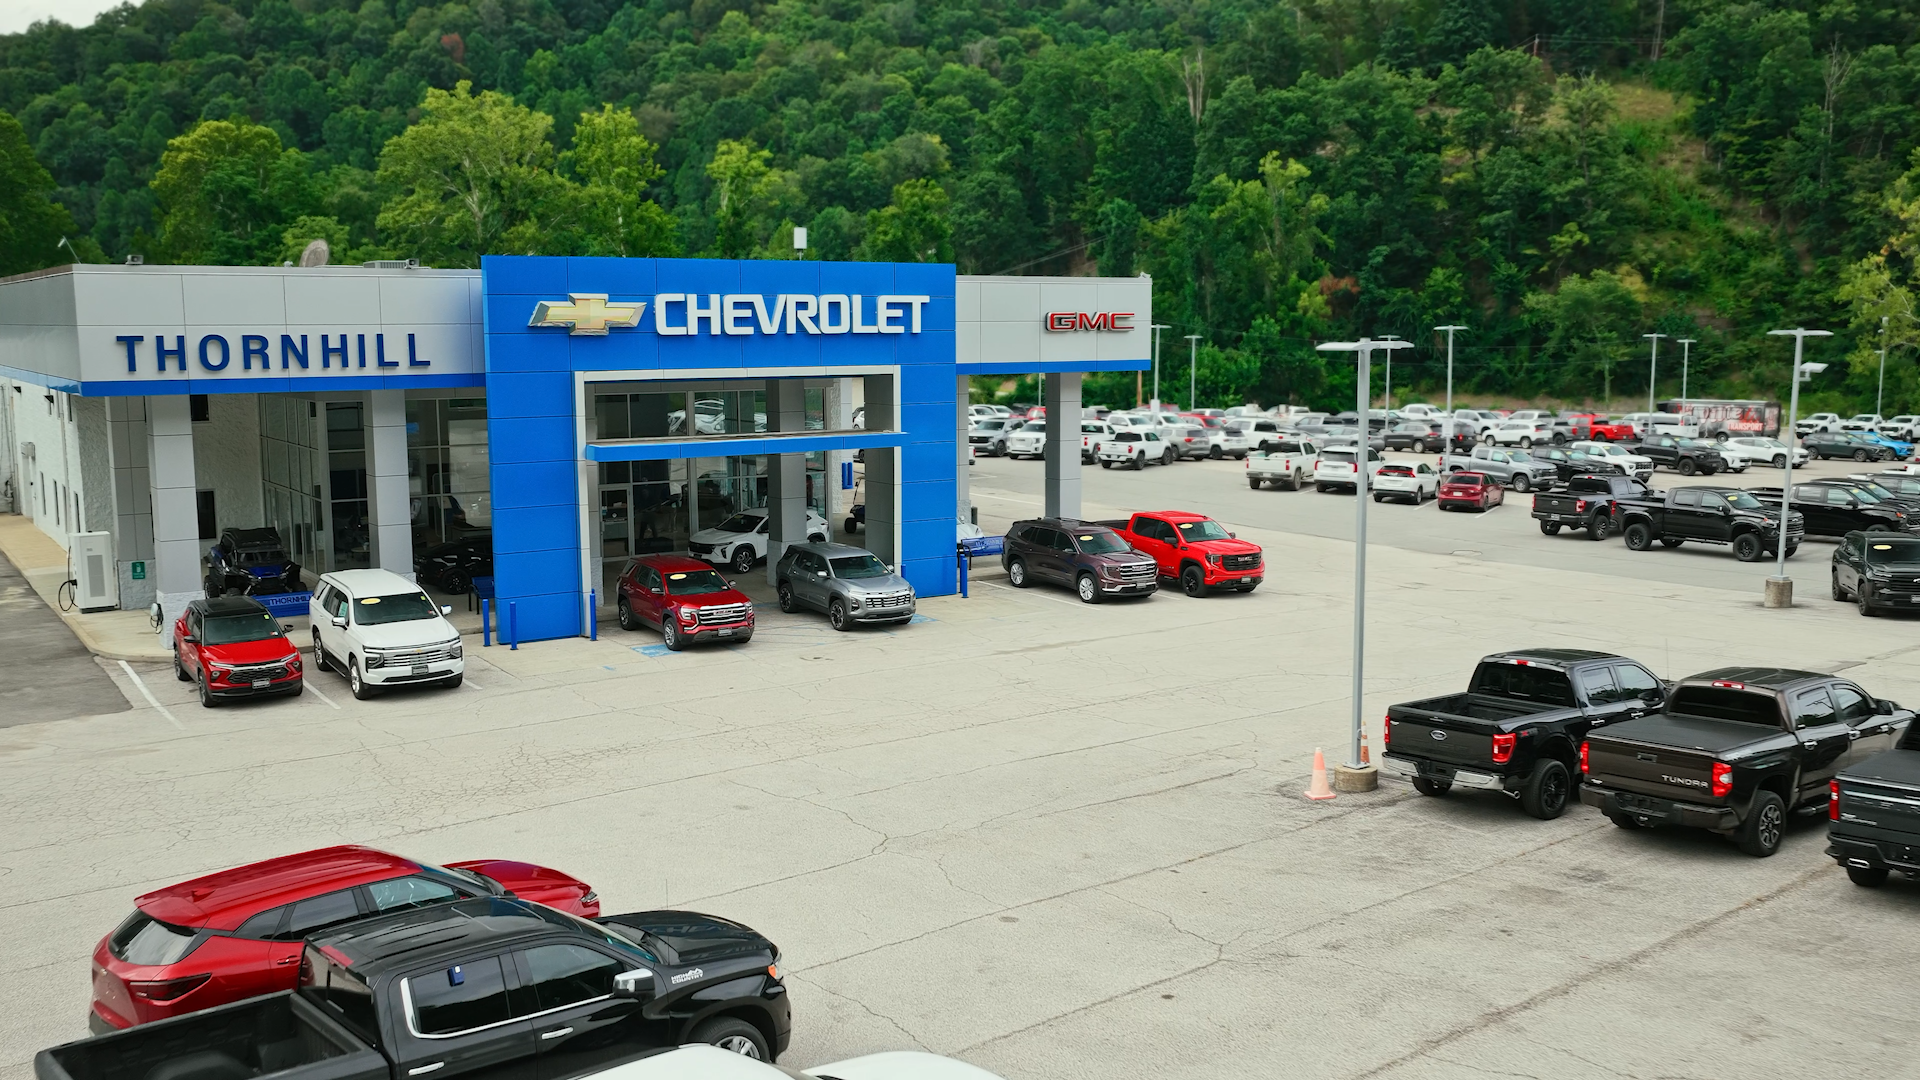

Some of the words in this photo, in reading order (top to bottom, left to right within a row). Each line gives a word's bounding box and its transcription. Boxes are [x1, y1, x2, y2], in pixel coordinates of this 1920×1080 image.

[655, 293, 930, 336] CHEVROLET
[1045, 311, 1135, 332] GMC
[115, 332, 432, 373] THORNHILL
[1727, 422, 1764, 432] TRANSPORT
[1661, 774, 1709, 789] TUNDRA
